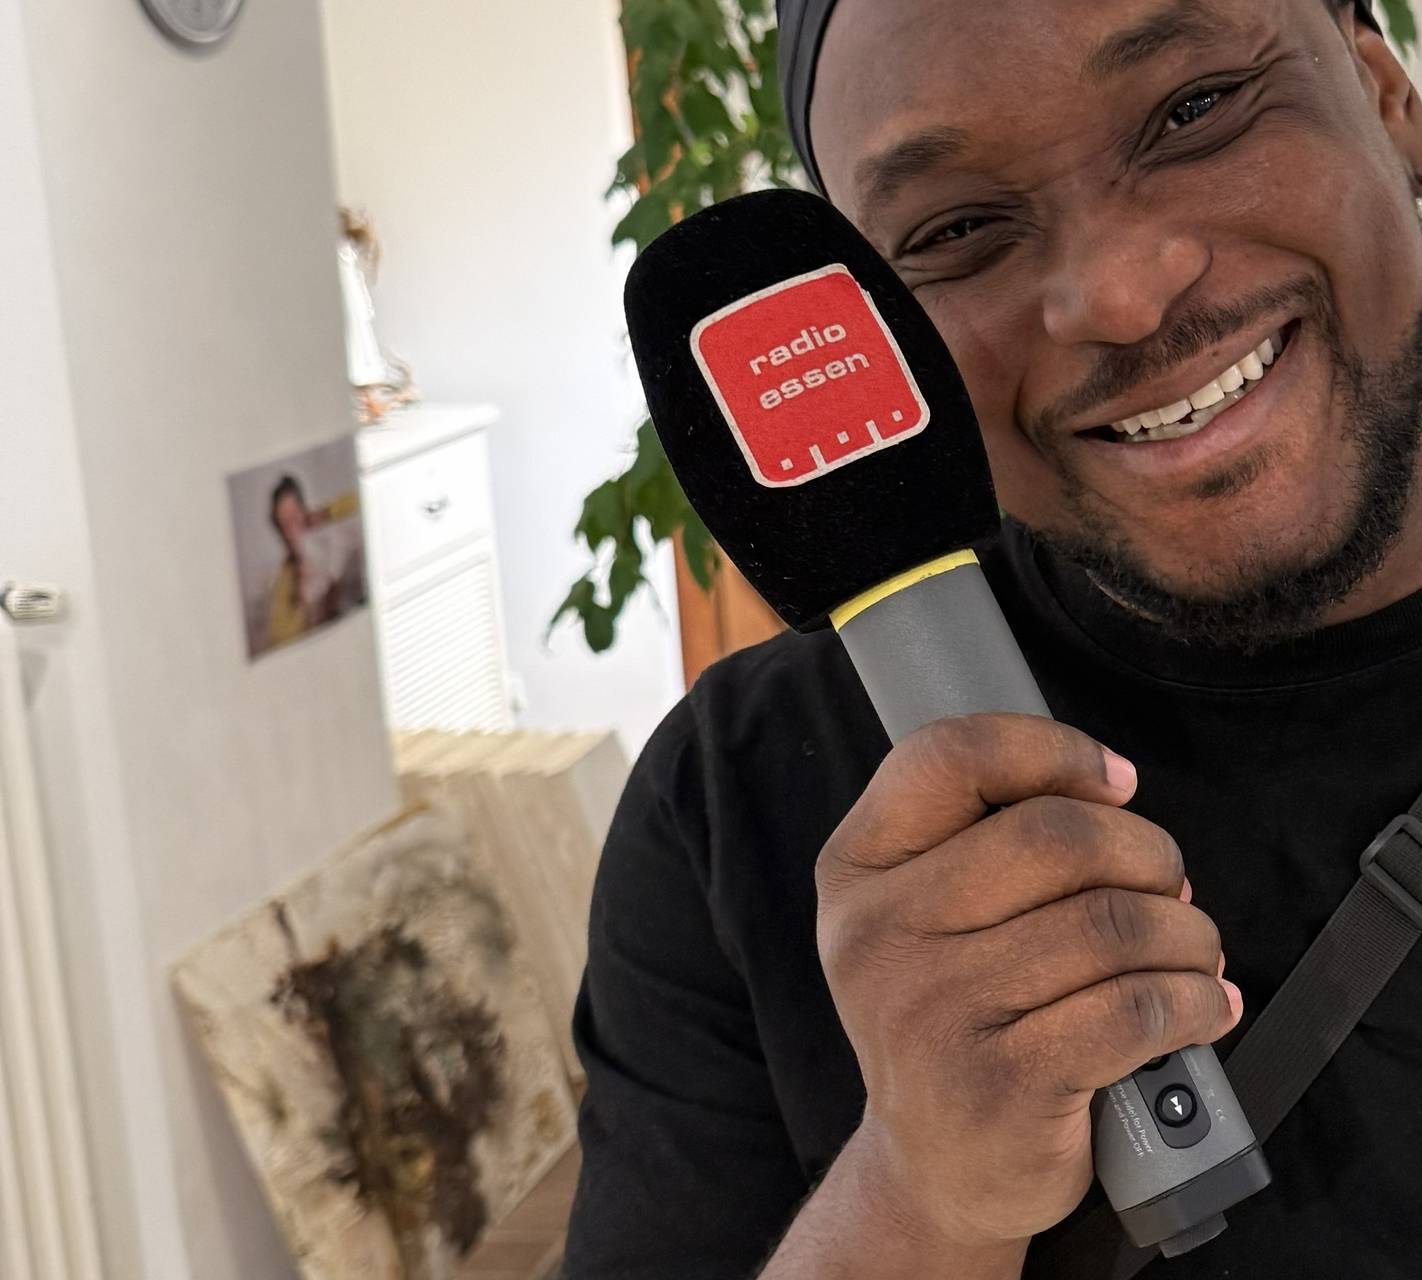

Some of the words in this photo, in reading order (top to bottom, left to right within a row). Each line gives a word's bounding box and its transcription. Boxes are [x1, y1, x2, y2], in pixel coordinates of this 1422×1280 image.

[749, 324, 846, 376] radio
[760, 353, 870, 410] essen
[1138, 1129, 1153, 1153] Power
